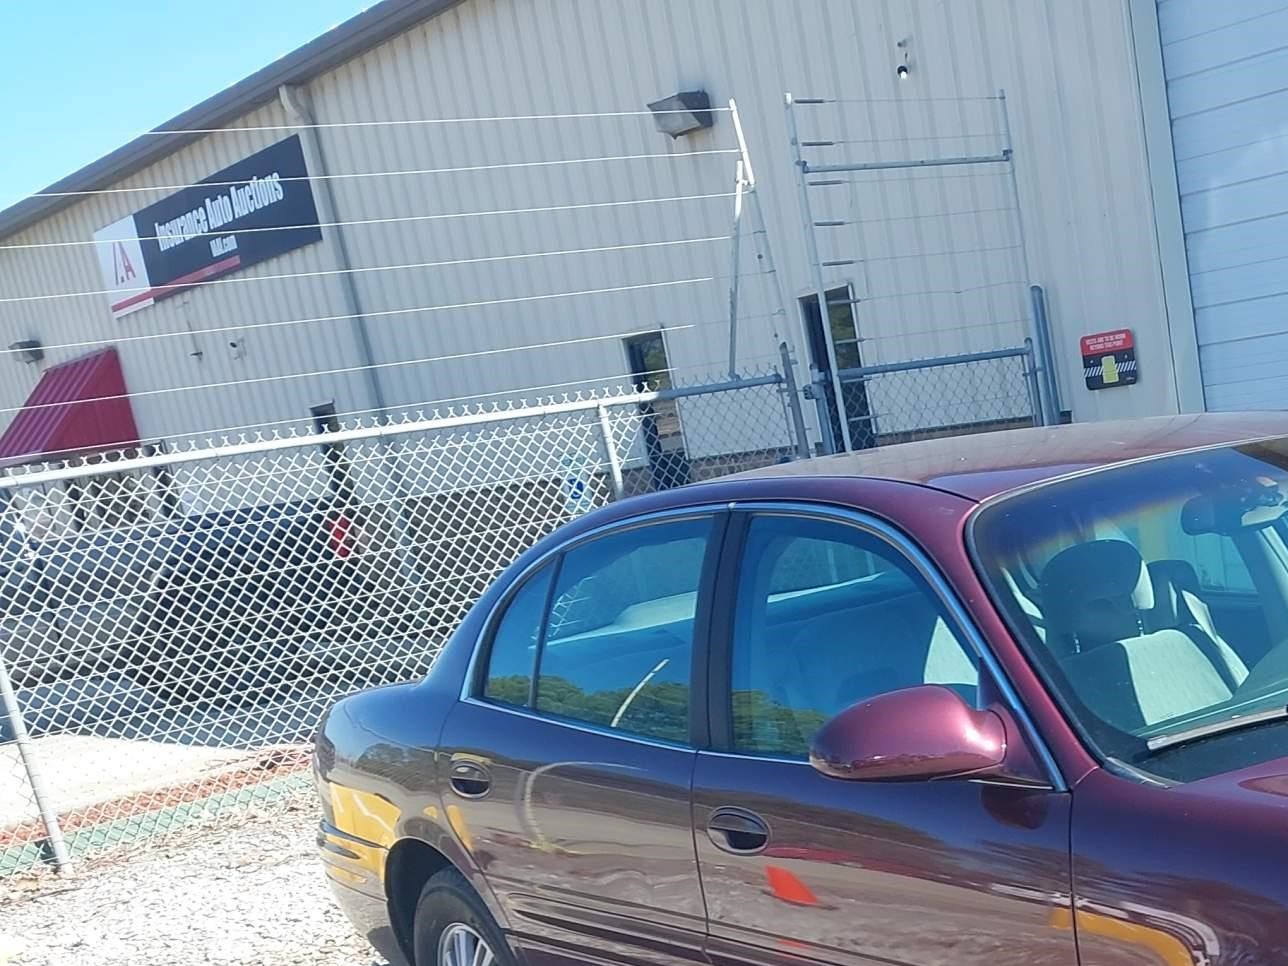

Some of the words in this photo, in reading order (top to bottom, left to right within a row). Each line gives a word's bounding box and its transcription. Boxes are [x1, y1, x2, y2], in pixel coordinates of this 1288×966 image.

[154, 206, 209, 251] Insurance
[205, 195, 233, 230] Auto
[229, 172, 284, 219] Auctions
